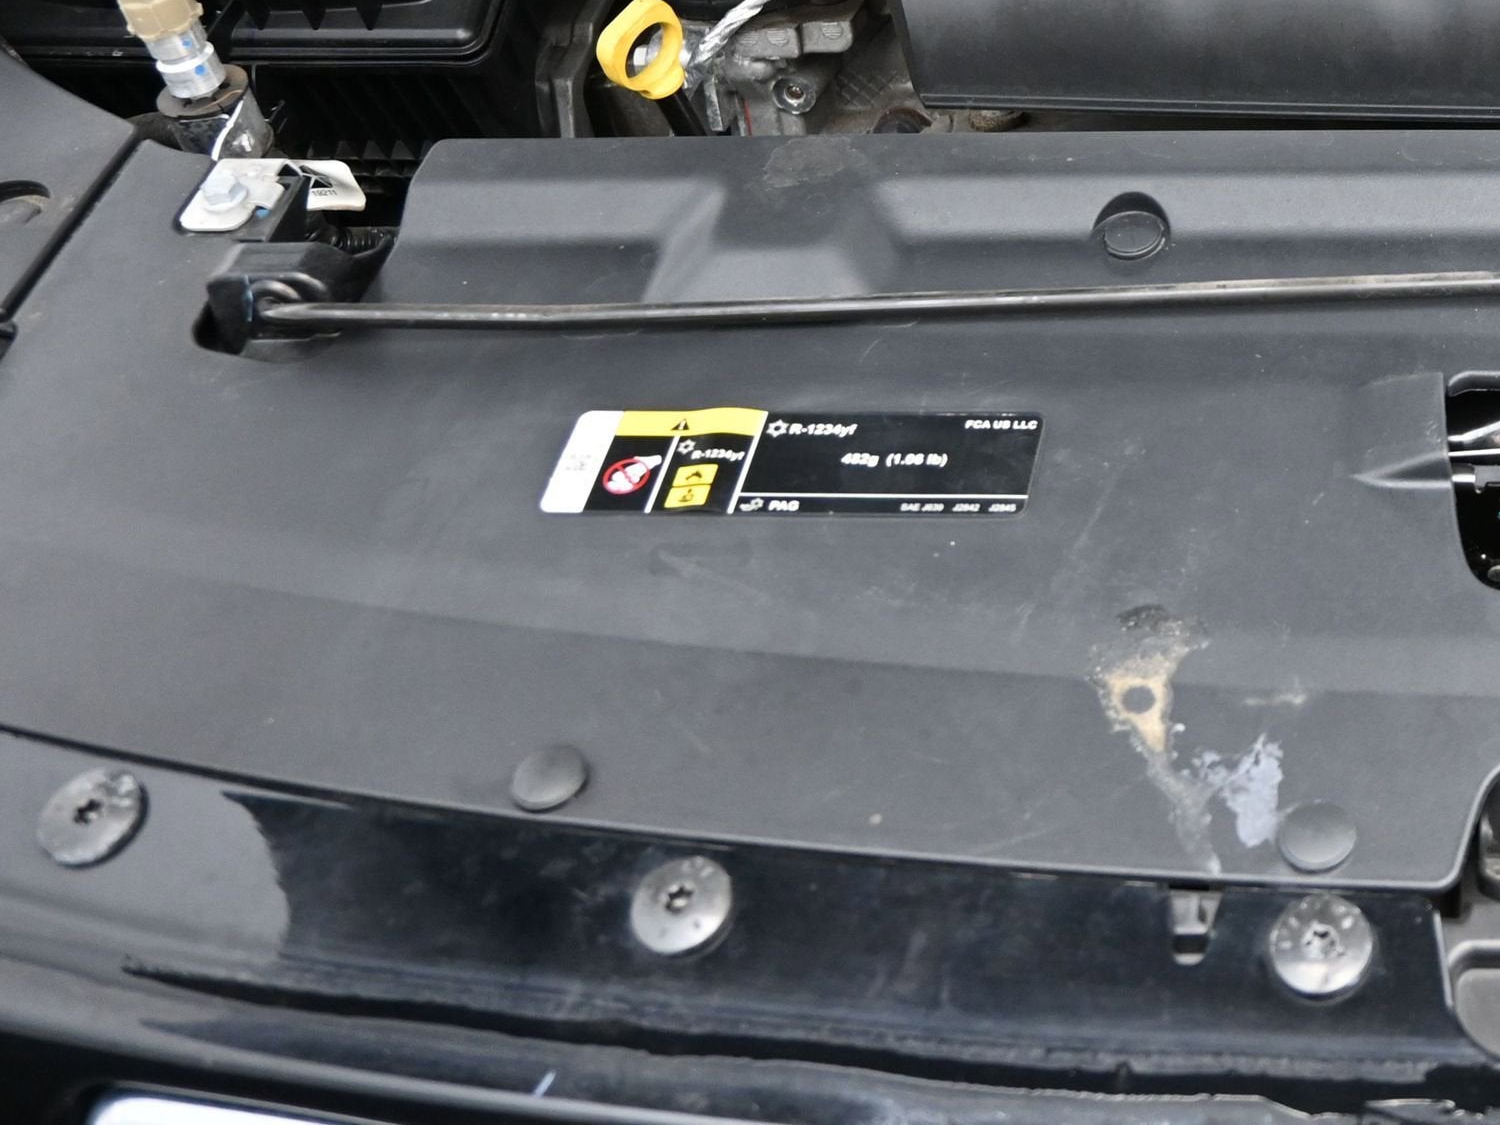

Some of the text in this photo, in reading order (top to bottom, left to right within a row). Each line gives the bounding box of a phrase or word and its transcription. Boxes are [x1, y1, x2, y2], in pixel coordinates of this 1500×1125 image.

[788, 423, 859, 438] R-1234yf
[964, 419, 1039, 430] FCA US LLC
[768, 499, 800, 512] PAG
[900, 502, 920, 512] SAE
